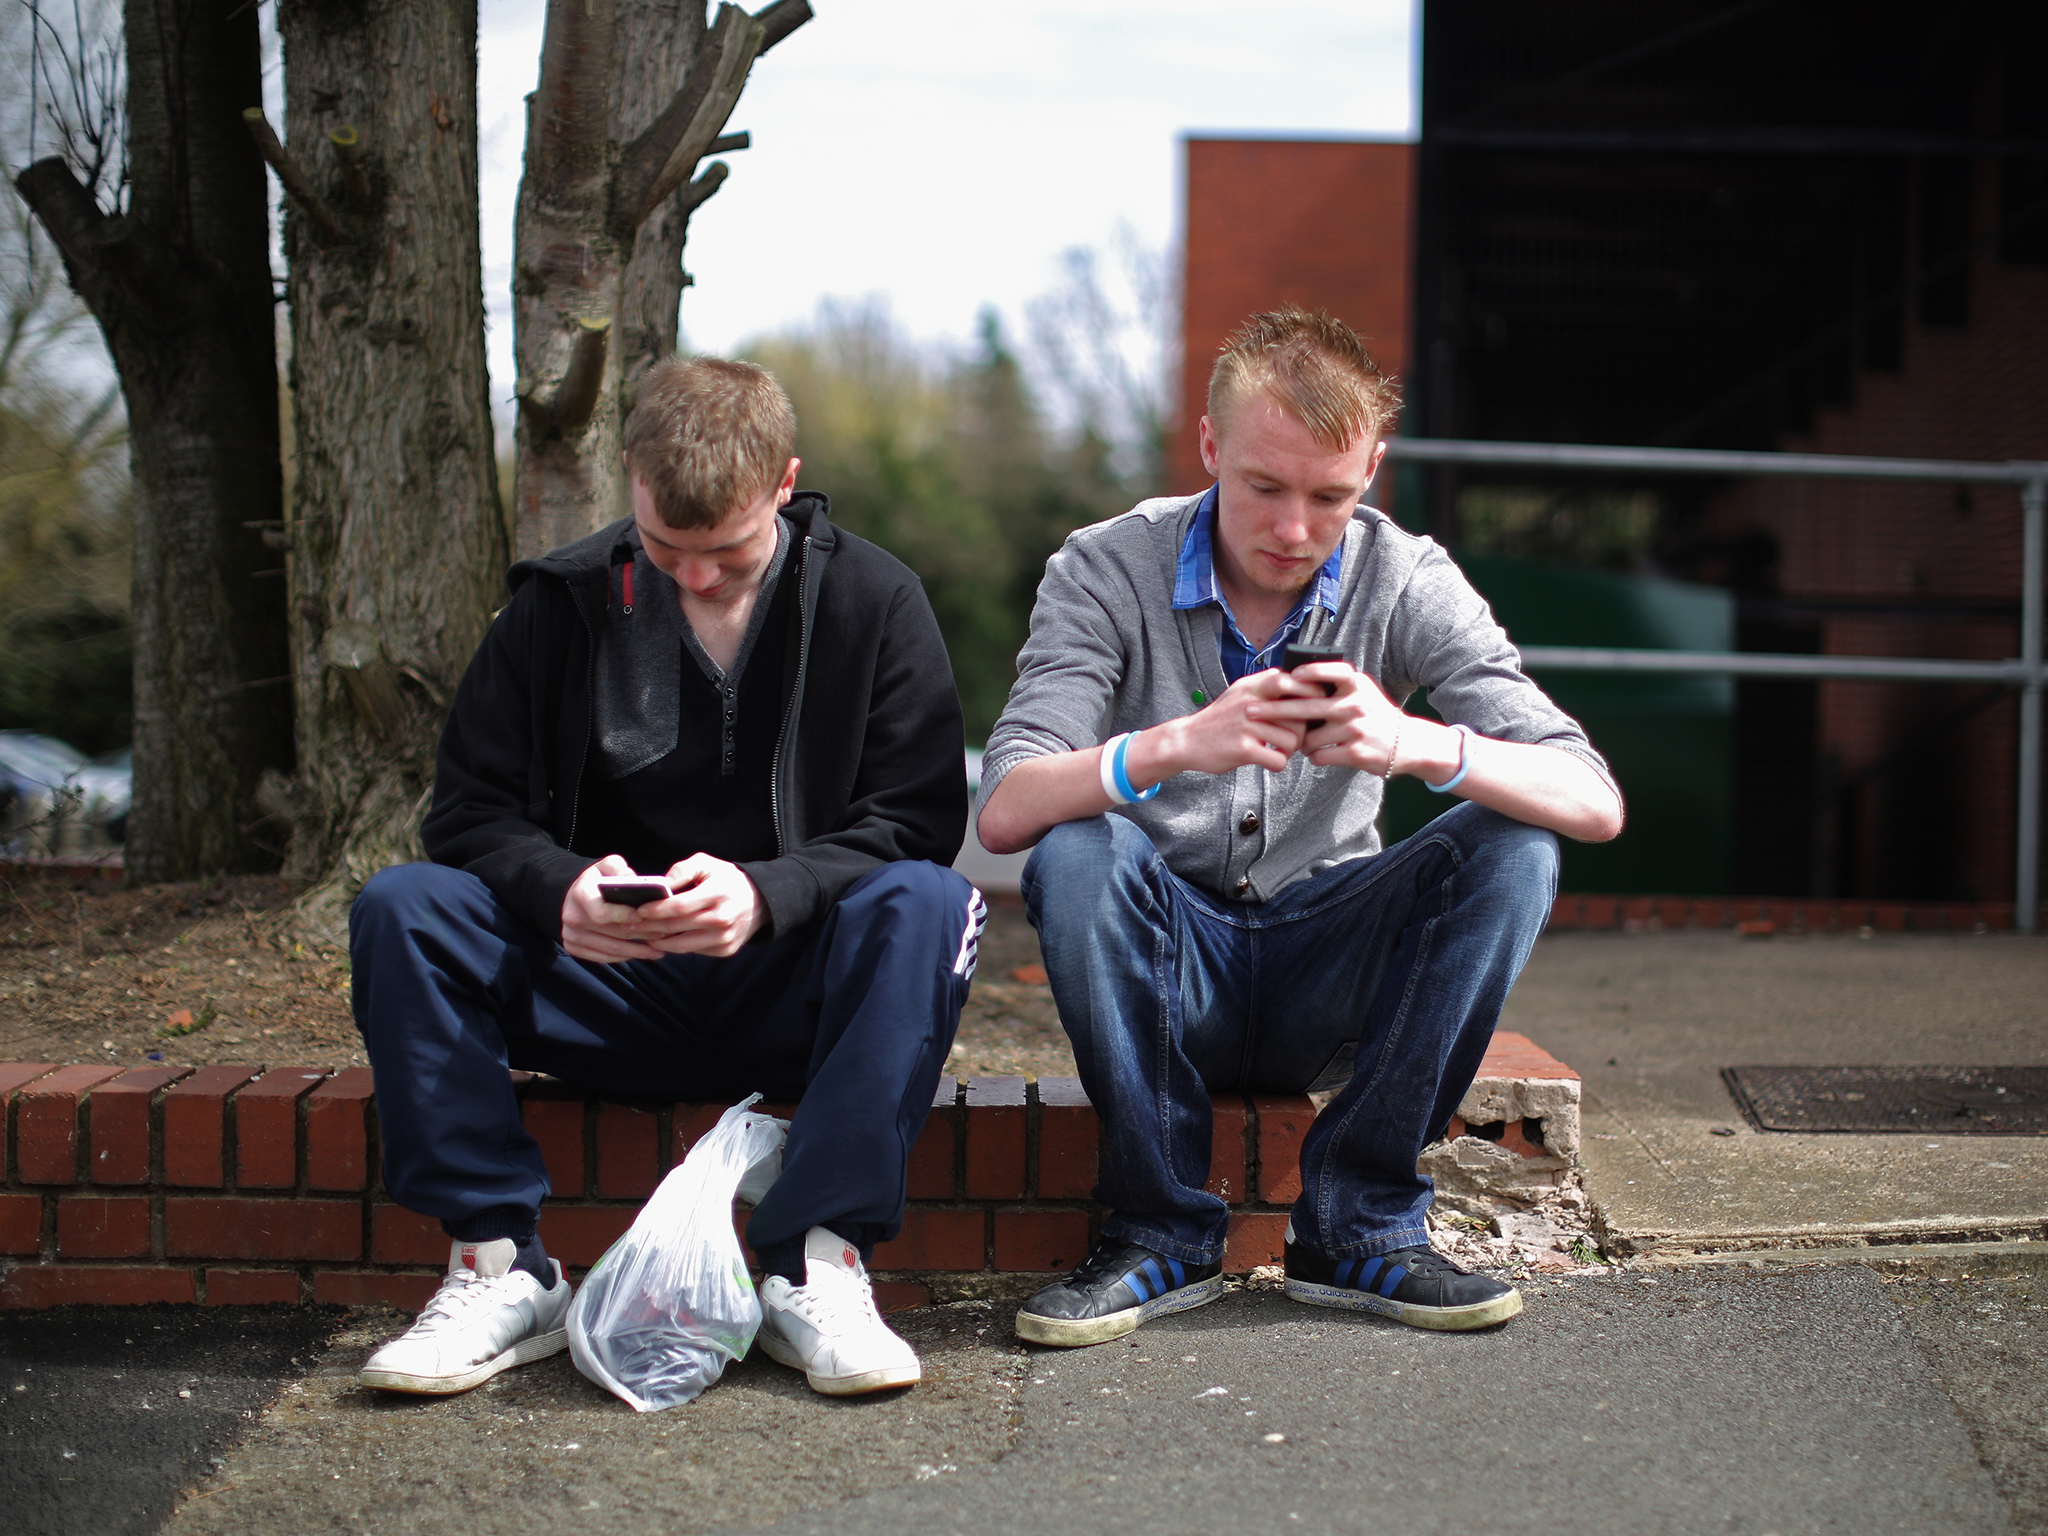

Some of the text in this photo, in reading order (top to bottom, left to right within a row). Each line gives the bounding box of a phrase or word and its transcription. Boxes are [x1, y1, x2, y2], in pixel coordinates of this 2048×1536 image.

[1180, 1286, 1208, 1298] adidas
[1319, 1288, 1353, 1299] adidas
[1353, 1301, 1383, 1313] adidas
